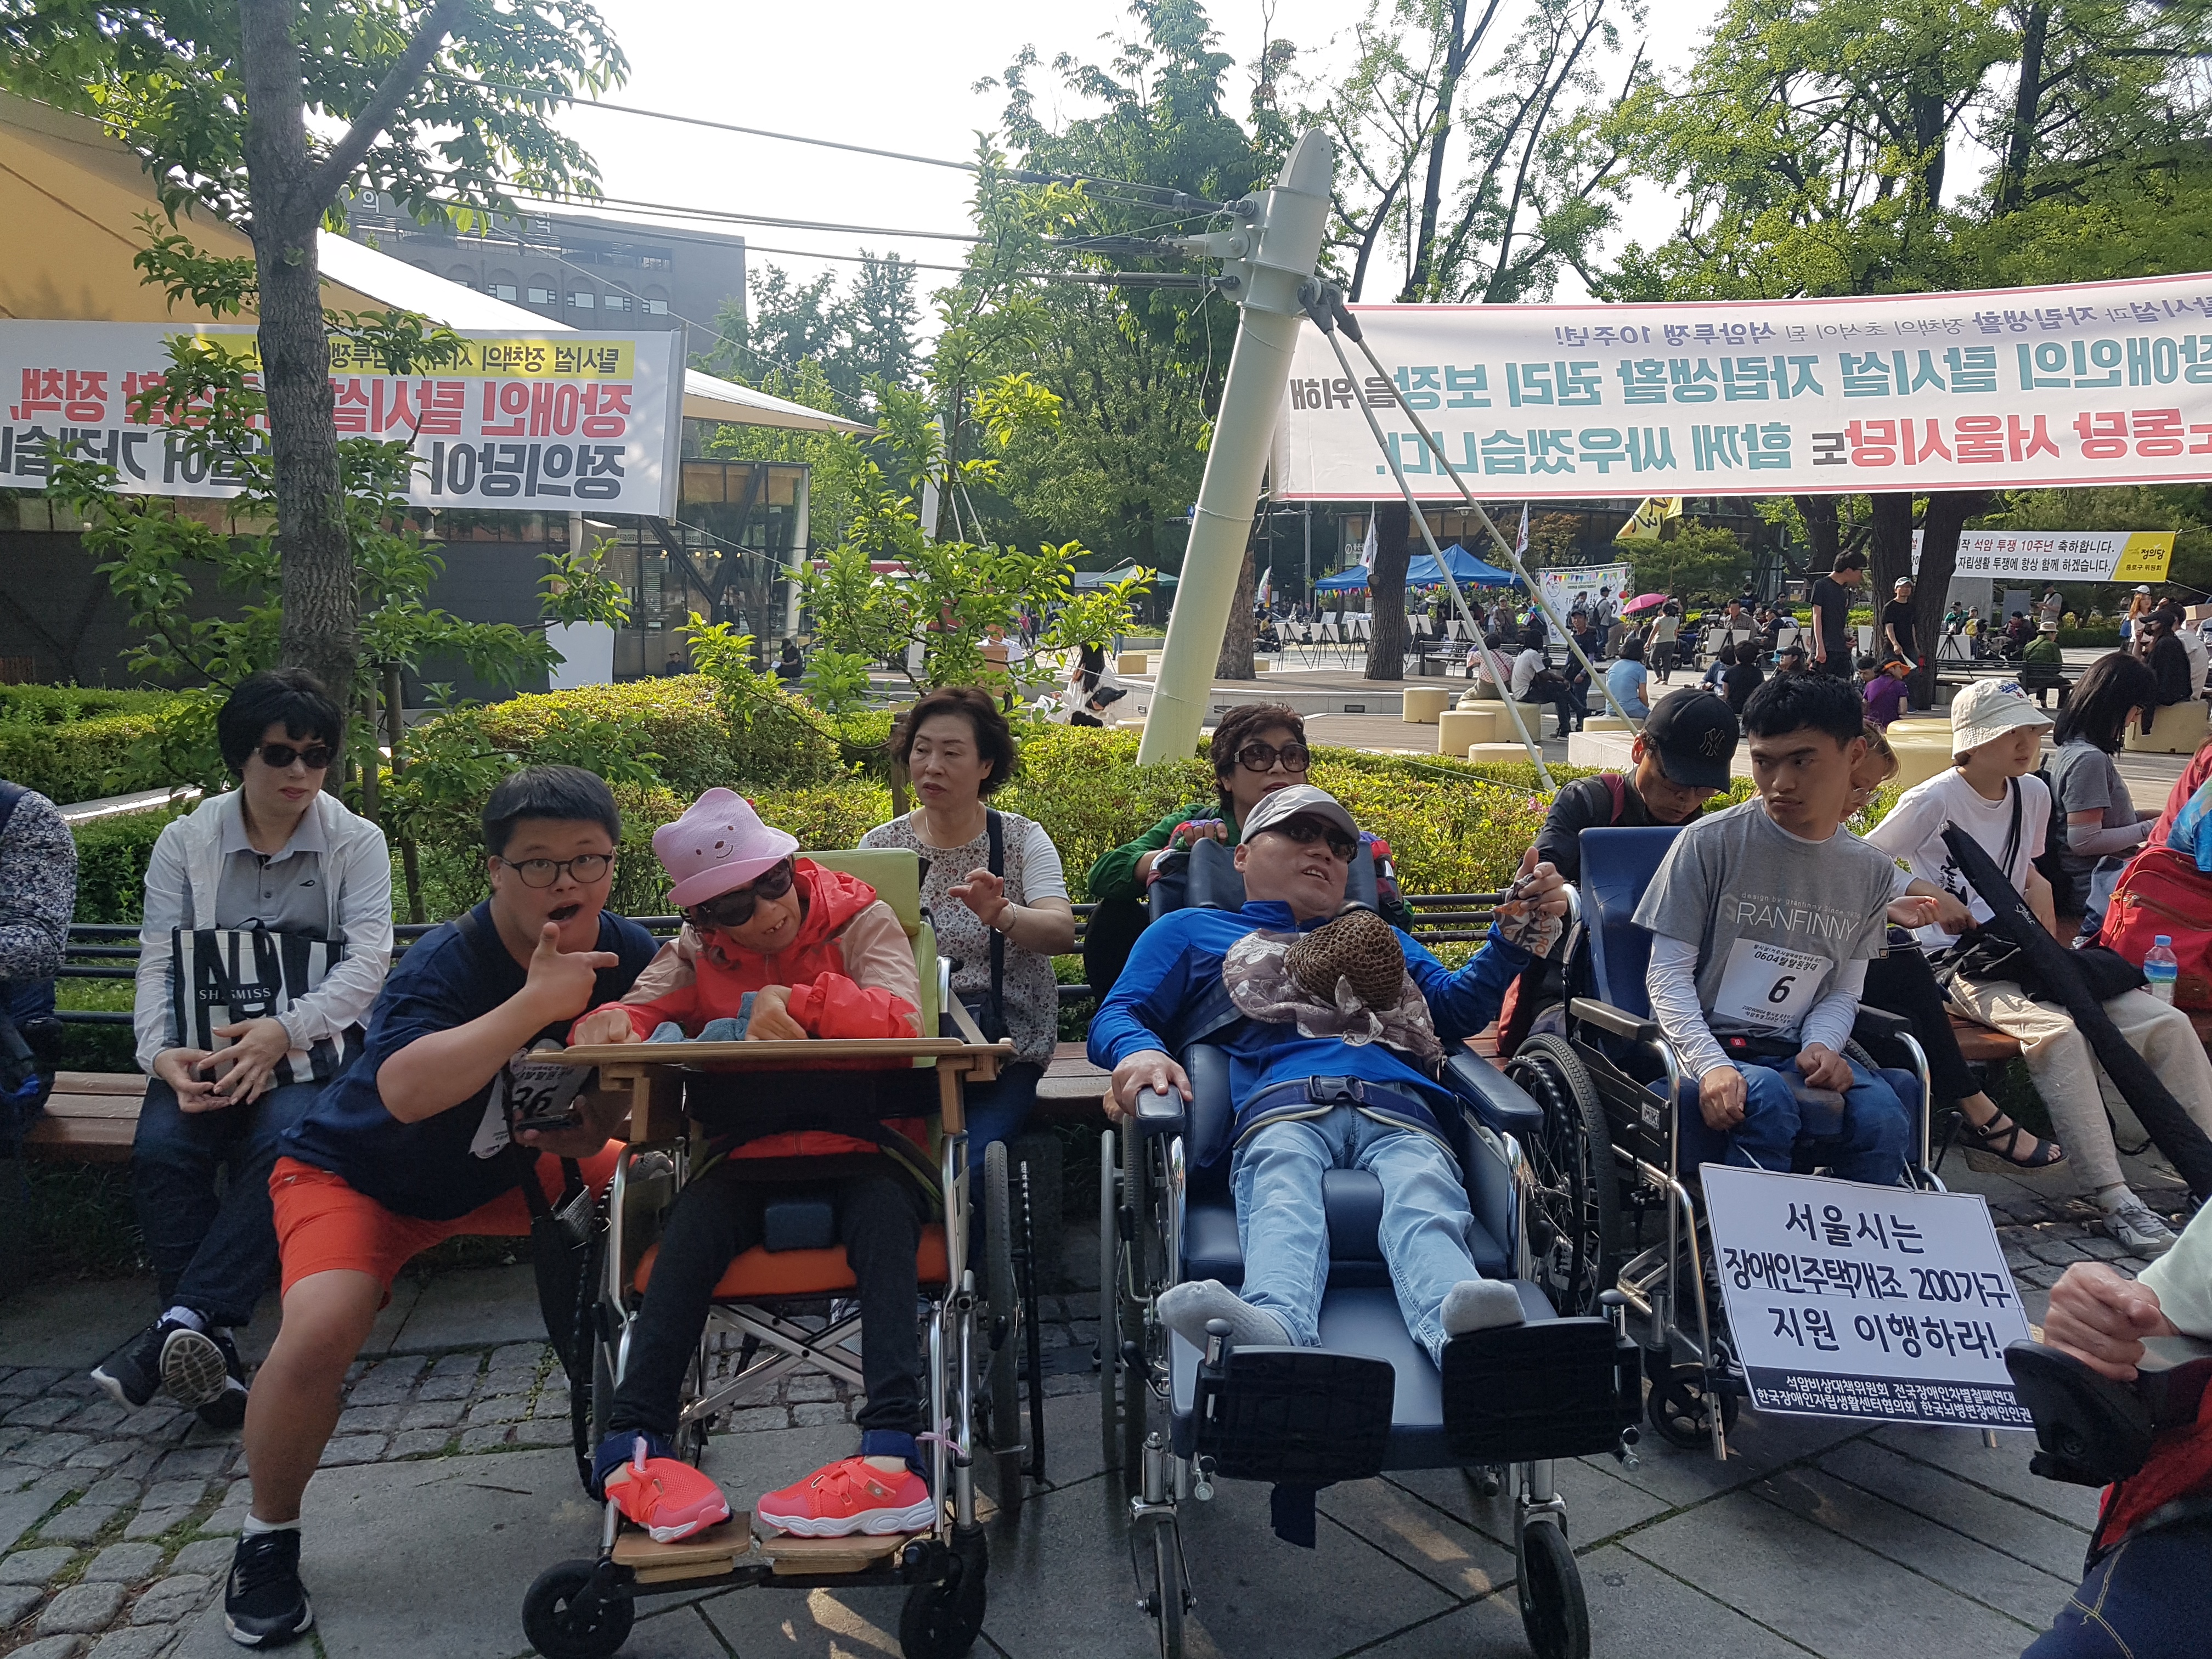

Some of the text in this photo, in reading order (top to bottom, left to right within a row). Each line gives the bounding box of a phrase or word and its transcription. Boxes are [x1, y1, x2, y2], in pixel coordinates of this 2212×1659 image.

[1974, 539, 1993, 551] 석암
[1996, 539, 2017, 552] 투쟁
[2021, 540, 2054, 553] 10주년
[2058, 540, 2114, 554] 축하합니다.
[2141, 549, 2165, 560] 정의당
[1958, 556, 2111, 572] 자립생활 투쟁에 항상 함께 하겠습니다.
[1768, 975, 1797, 1003] 6
[1785, 1202, 1925, 1254] 서울시는
[1723, 1246, 2012, 1308] 장애인주택개조 200가구
[1768, 1307, 2002, 1359] 지원 이행하라!
[1756, 1387, 1917, 1414] 한국장애인자립생활센터협의회
[1786, 1375, 2017, 1406] 석암비상대책위원회 전국장애인차별철폐연대
